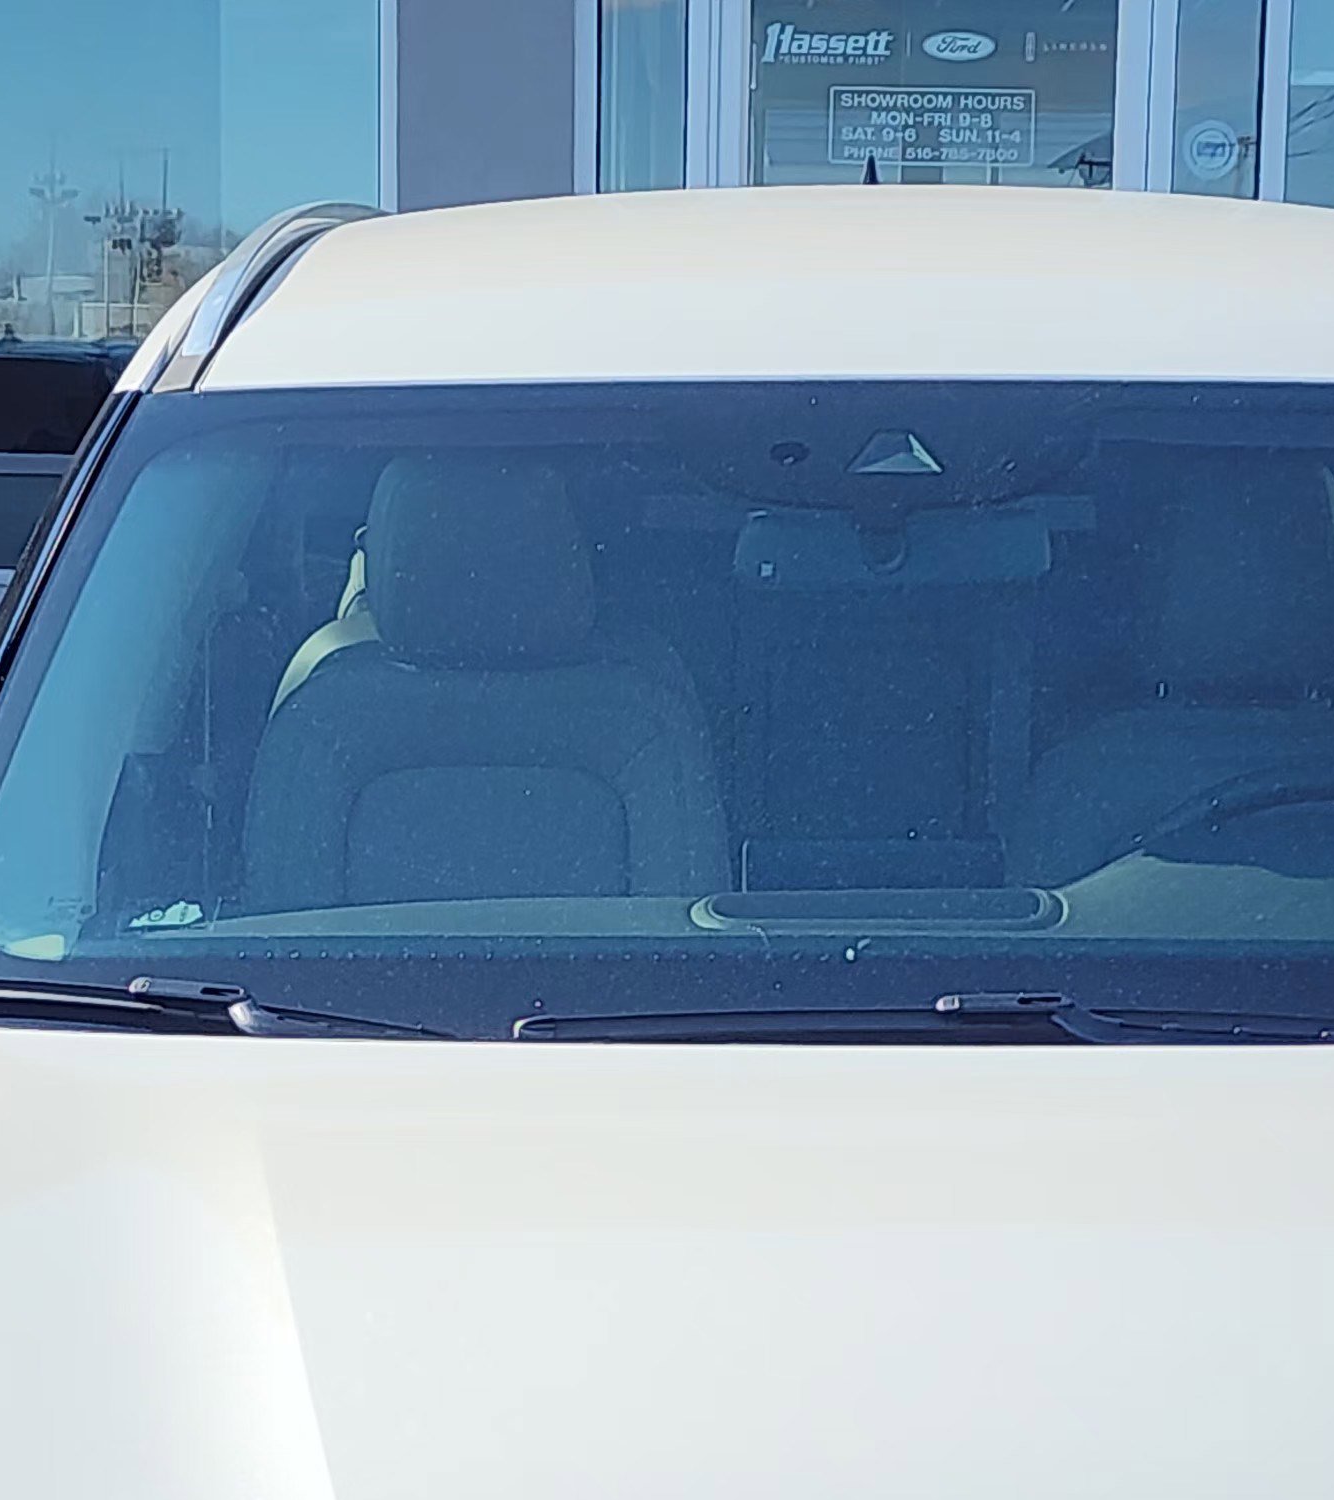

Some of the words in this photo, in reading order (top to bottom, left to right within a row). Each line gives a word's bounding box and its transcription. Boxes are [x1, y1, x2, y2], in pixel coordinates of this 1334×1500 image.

[761, 22, 894, 63] Hassett
[840, 93, 953, 109] SHOWROOM
[959, 95, 1025, 110] HOURS
[870, 111, 952, 127] MON-FRI
[841, 126, 876, 141] SAT.
[881, 127, 917, 142] 9-6
[938, 128, 982, 143] SUN.
[986, 129, 1021, 143] 11-4
